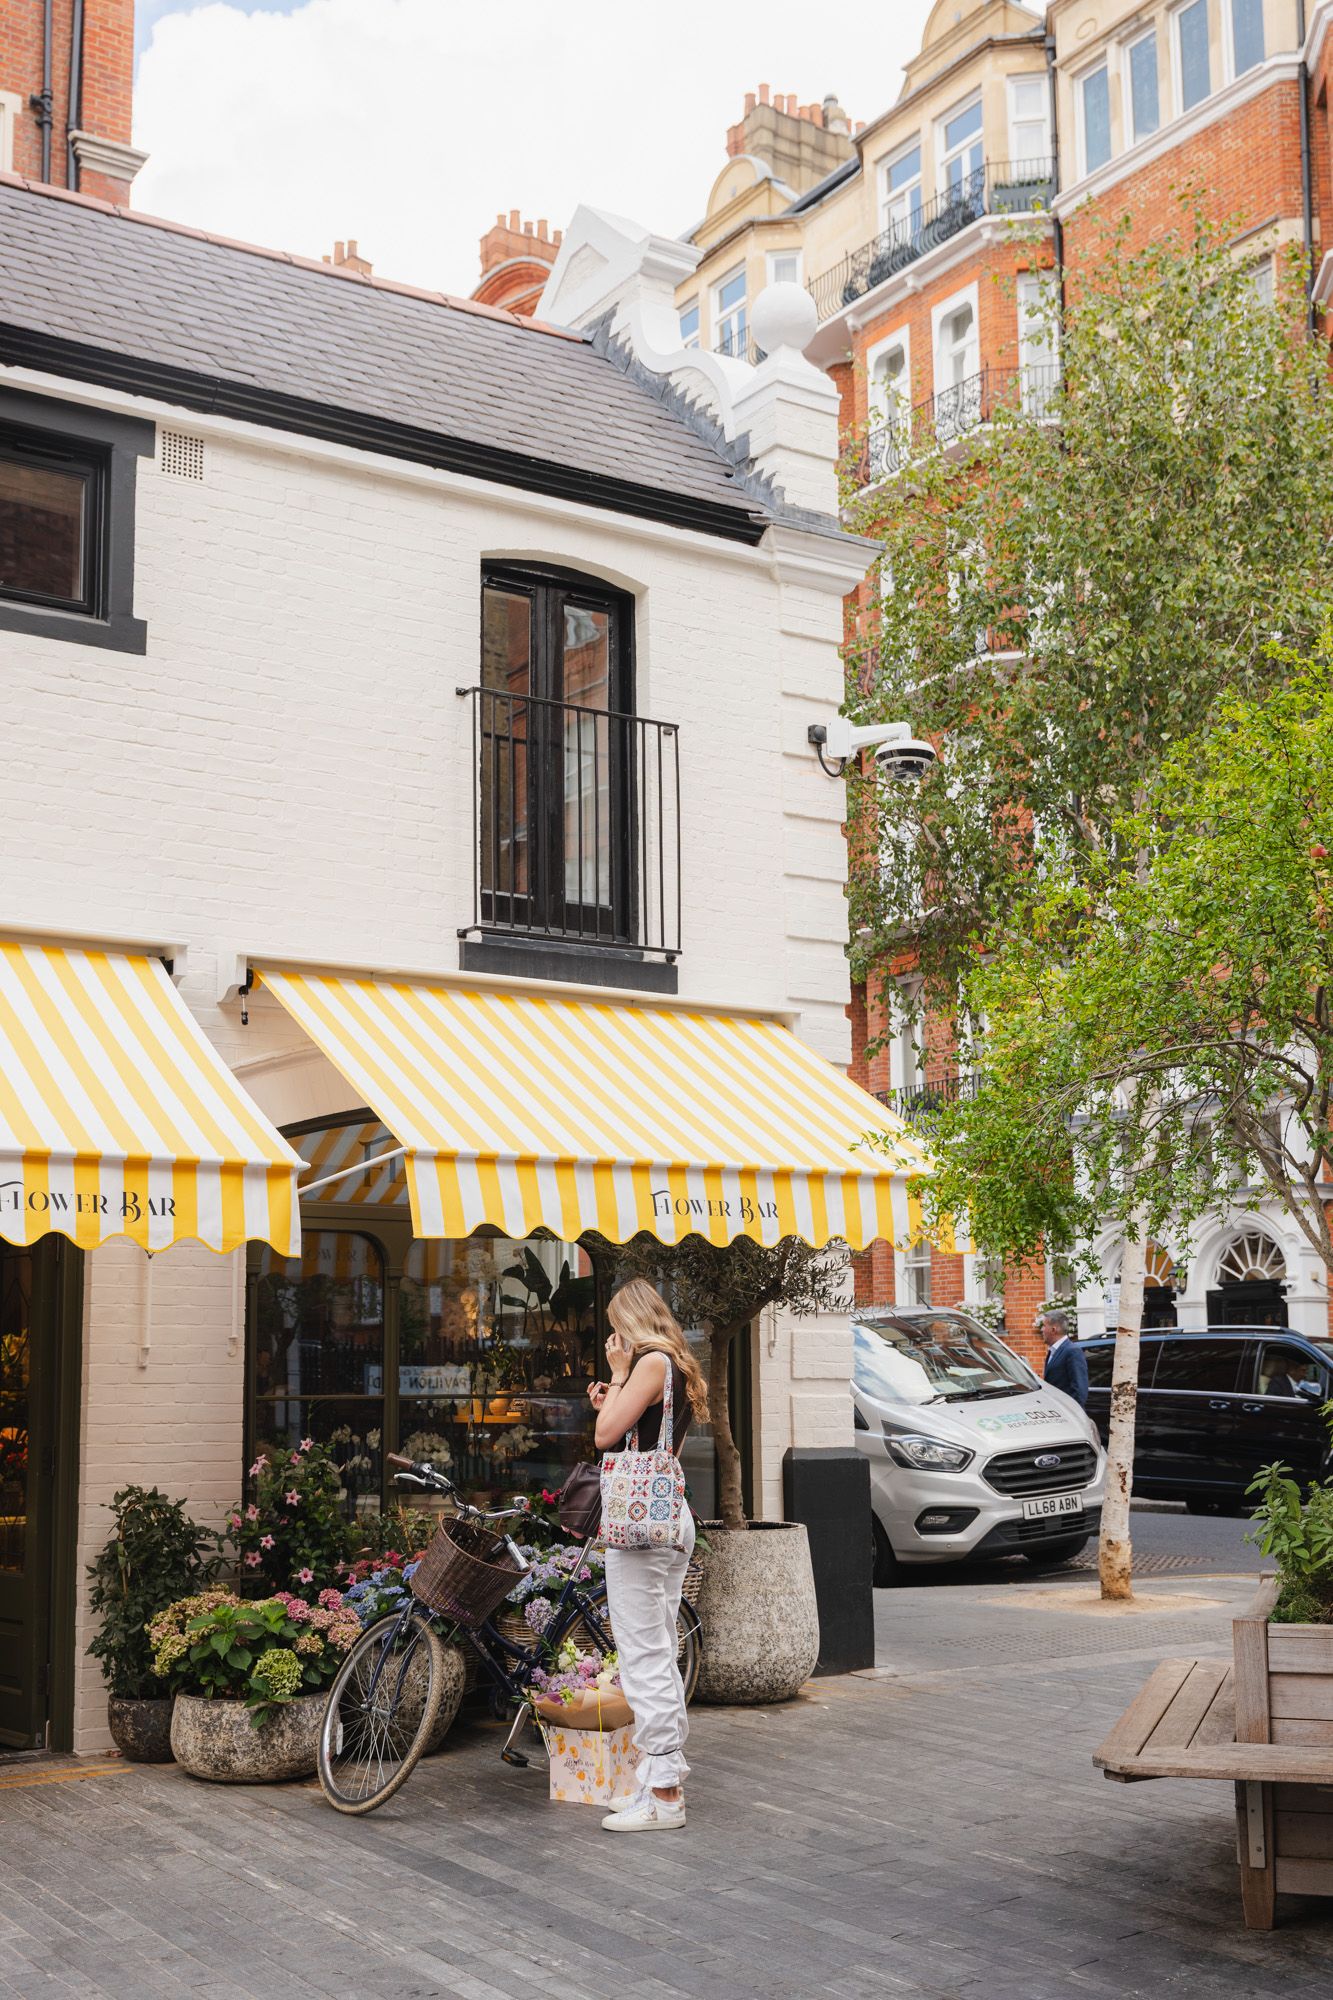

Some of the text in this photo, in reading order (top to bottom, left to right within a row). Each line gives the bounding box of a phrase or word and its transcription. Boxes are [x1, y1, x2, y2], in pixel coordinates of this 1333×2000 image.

[119, 1191, 176, 1223] BAR
[650, 1190, 779, 1224] FLOWER BAR
[997, 1410, 1062, 1423] ECO COLD
[1007, 1418, 1069, 1429] REFRIGERATION
[1028, 1496, 1078, 1516] LL68 ABN
